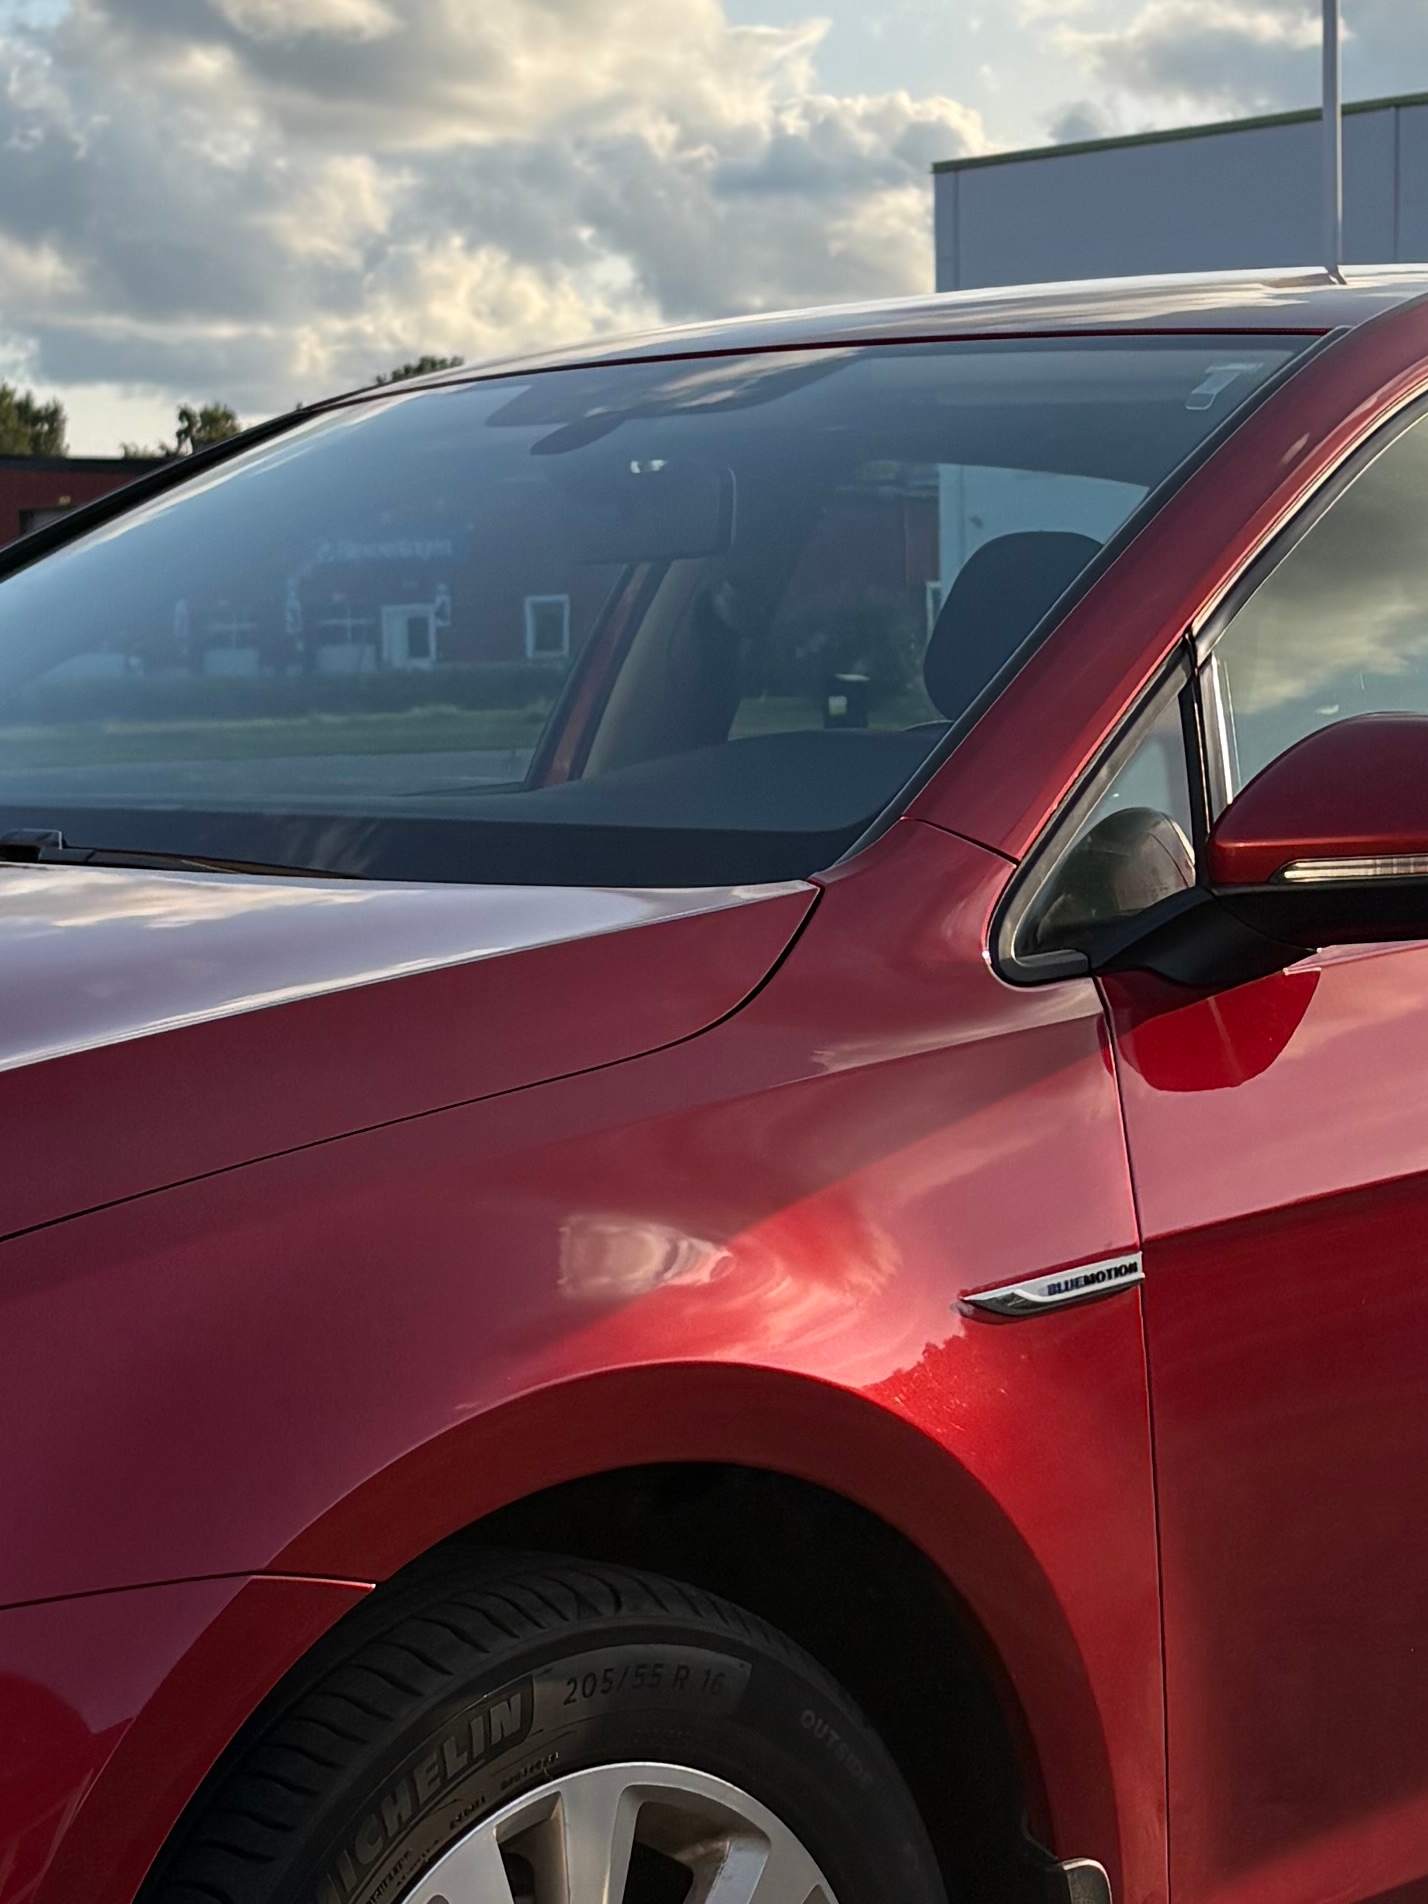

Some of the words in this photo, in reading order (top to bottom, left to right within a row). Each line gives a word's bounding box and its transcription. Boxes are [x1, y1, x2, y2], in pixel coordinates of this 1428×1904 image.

[1046, 1261, 1138, 1296] BLUEMOTION
[563, 1663, 664, 1707] 205/55
[671, 1662, 691, 1691] R
[699, 1668, 726, 1696] 16
